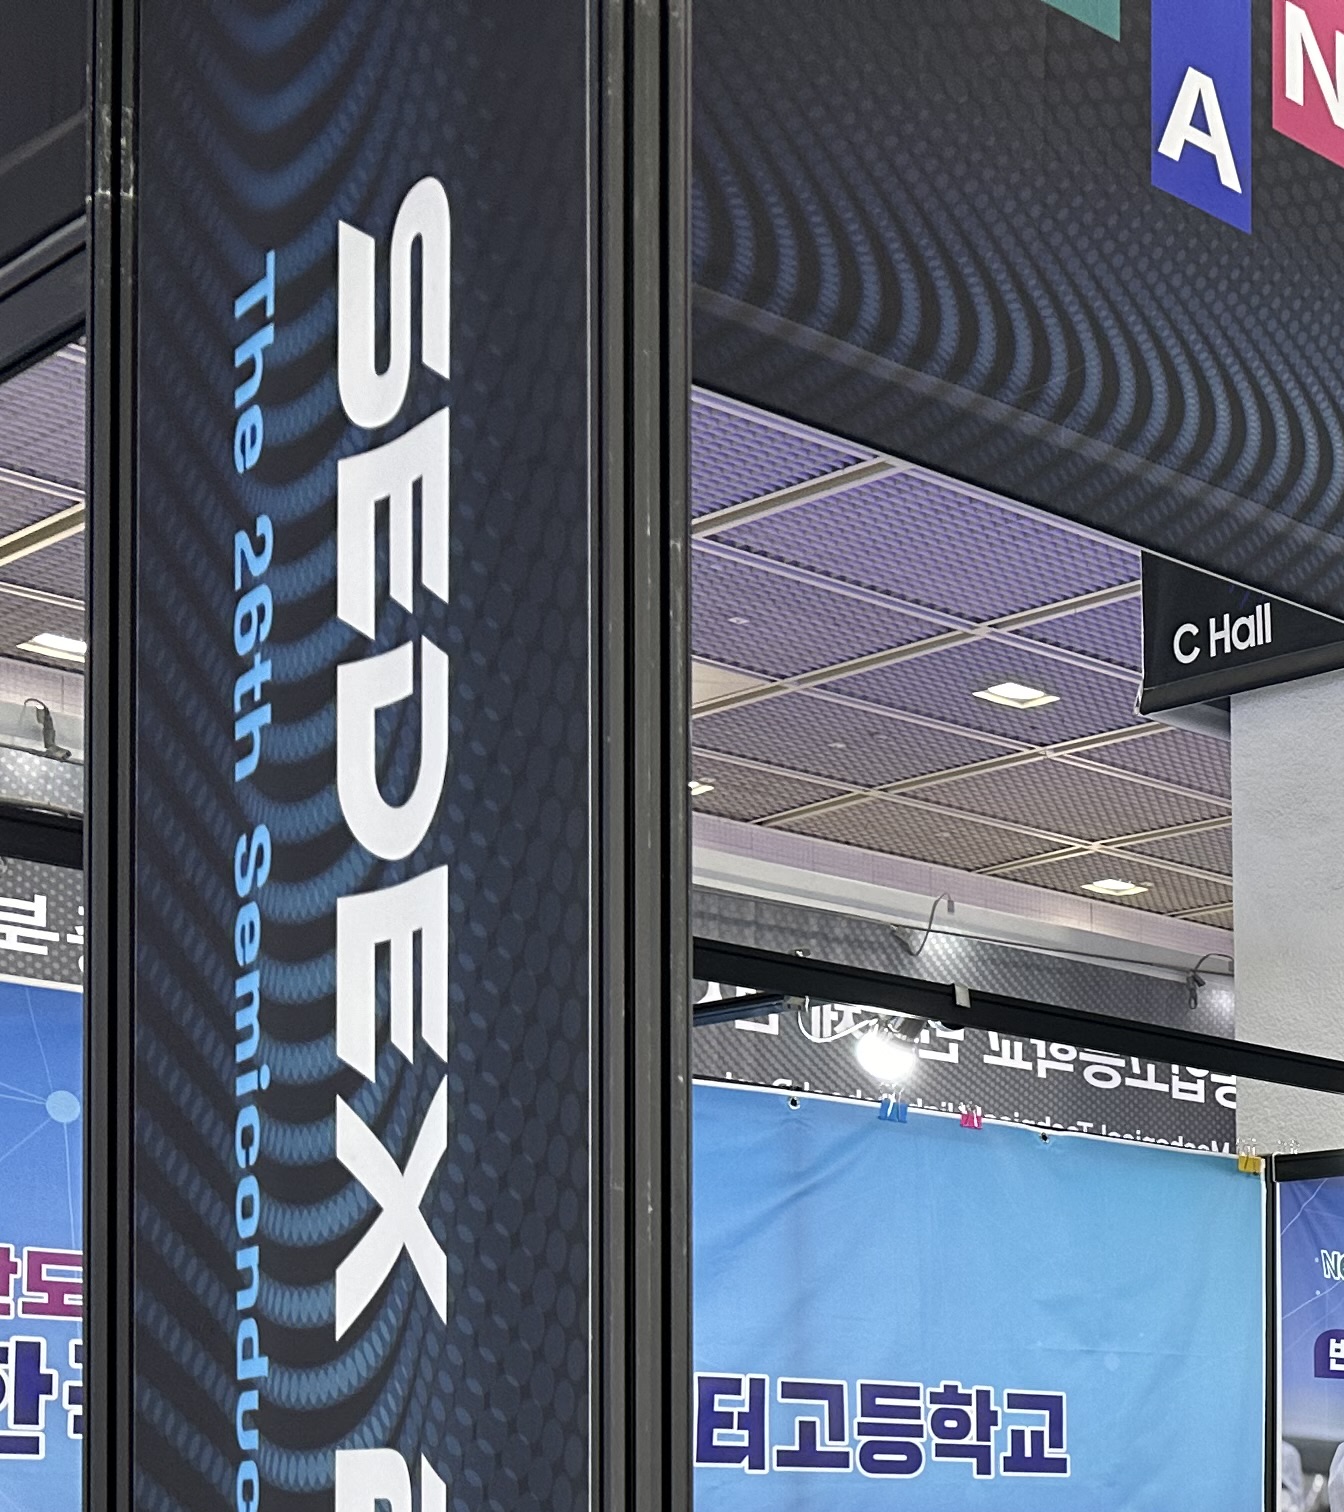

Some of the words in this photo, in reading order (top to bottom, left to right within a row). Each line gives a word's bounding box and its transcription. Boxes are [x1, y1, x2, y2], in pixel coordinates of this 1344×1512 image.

[233, 250, 275, 473] The
[233, 513, 274, 782] 26th
[1173, 624, 1200, 664] C
[1209, 603, 1272, 657] Hall
[336, 176, 451, 1342] SEDEX
